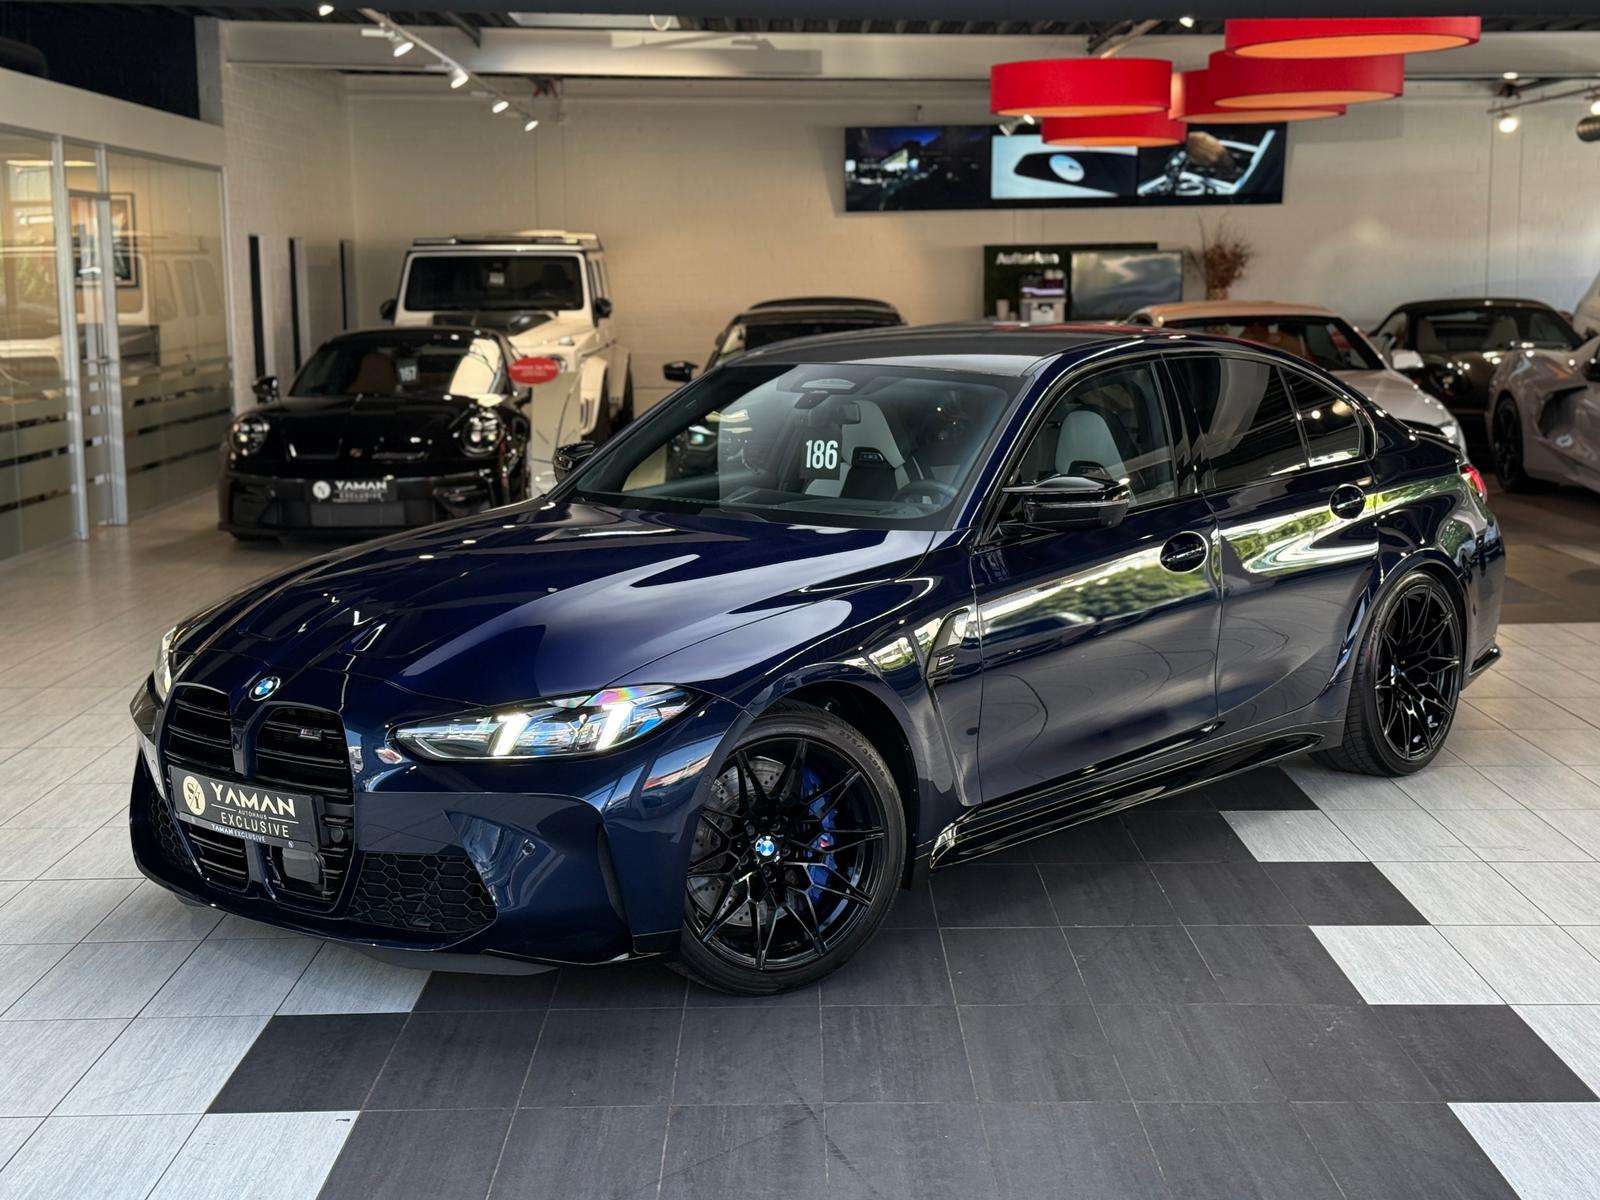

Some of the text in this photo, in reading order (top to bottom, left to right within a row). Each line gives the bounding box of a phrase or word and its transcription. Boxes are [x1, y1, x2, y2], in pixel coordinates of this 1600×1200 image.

[806, 440, 838, 469] 186
[334, 481, 387, 491] YAMAN
[210, 782, 296, 817] YAMAN
[220, 812, 290, 838] EXCLUSIVE
[238, 810, 267, 820] AUTOHAUS
[211, 823, 266, 843] YAMAN EXCLUSIVE
